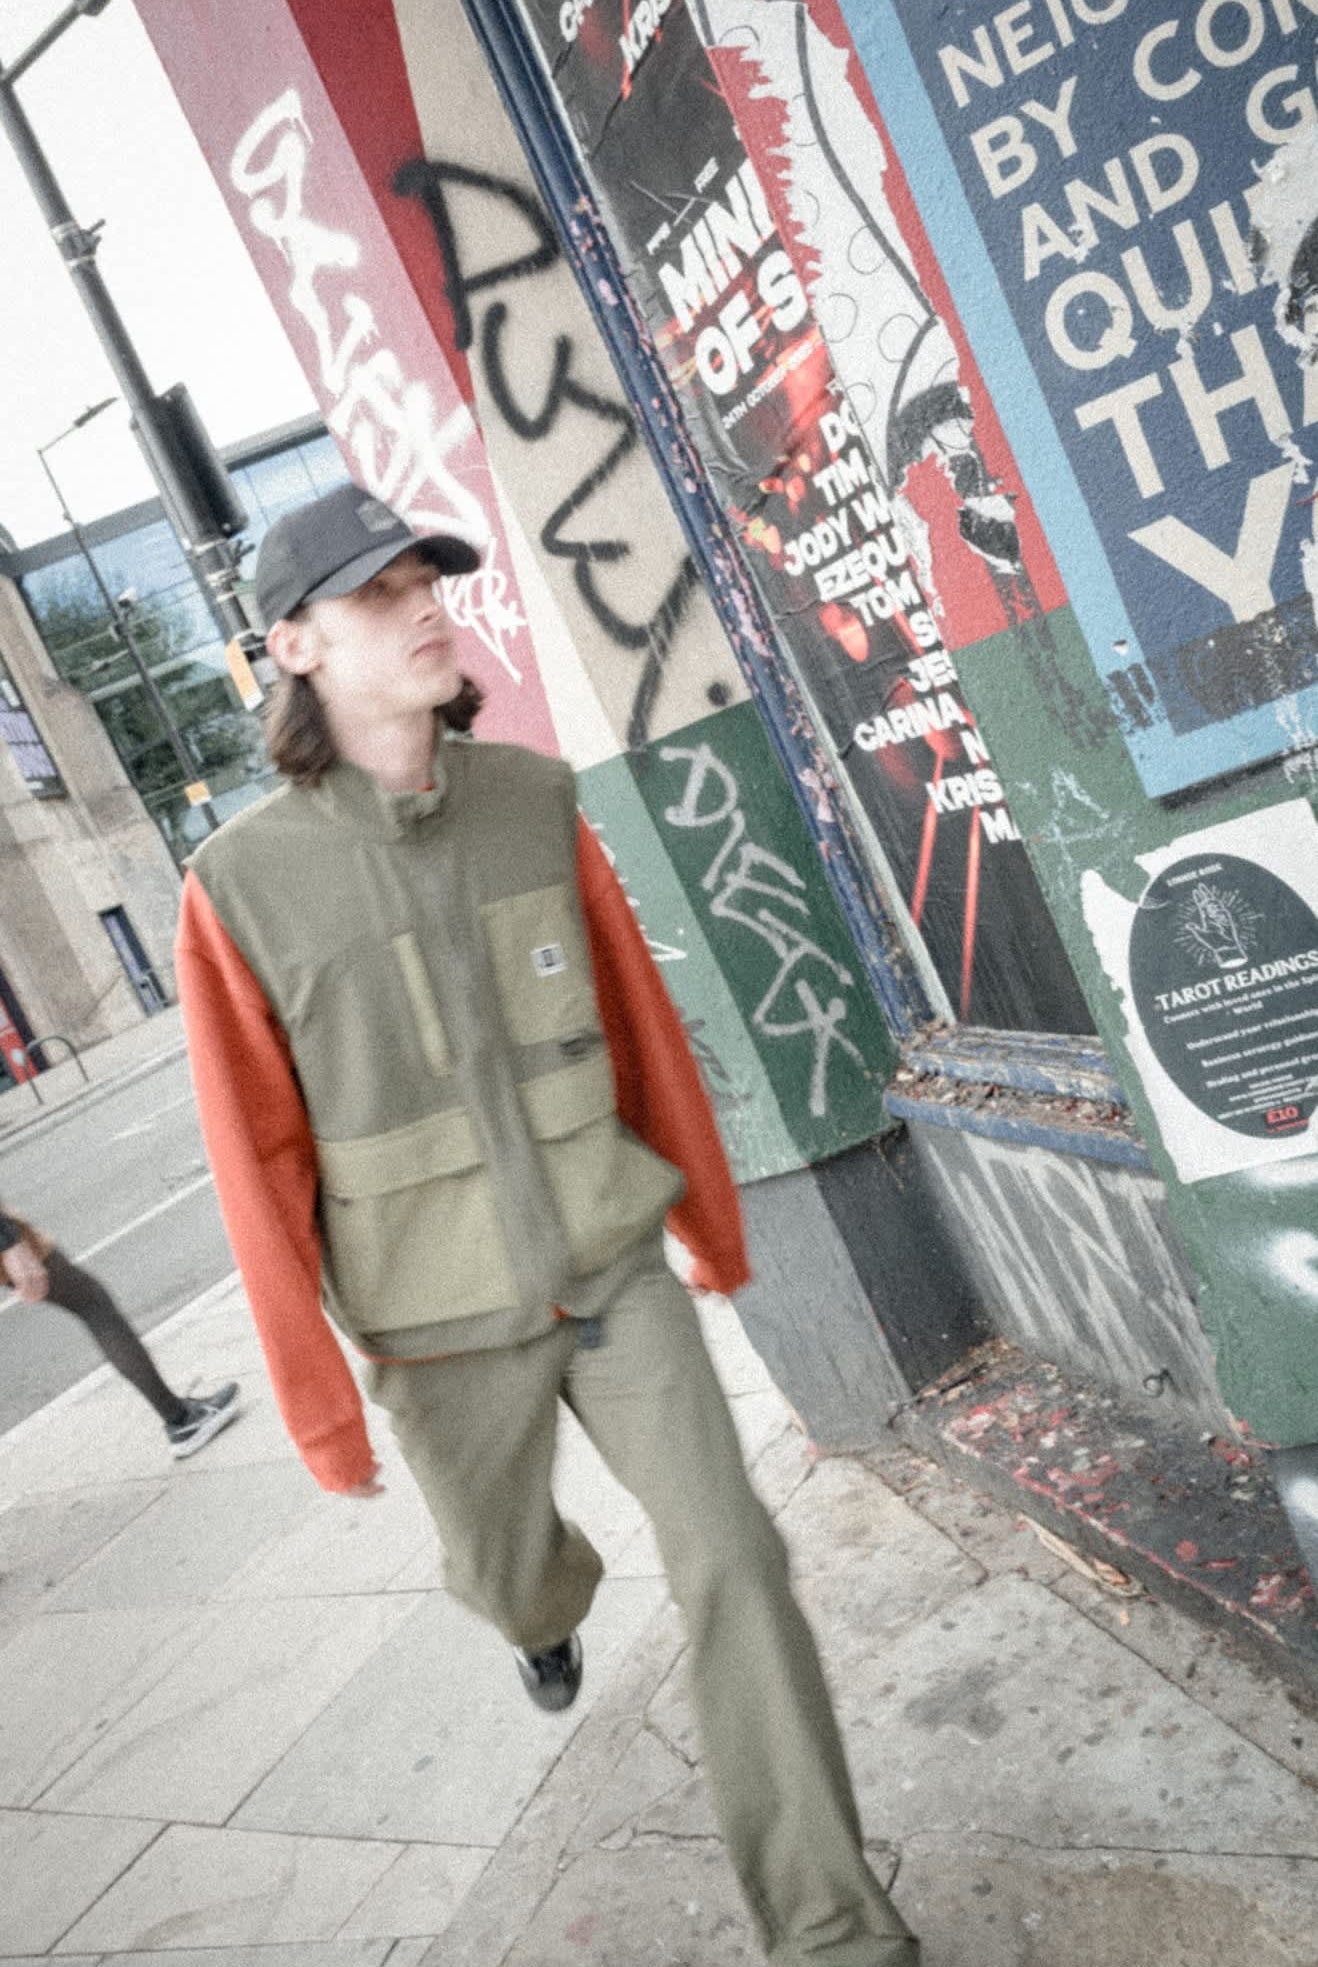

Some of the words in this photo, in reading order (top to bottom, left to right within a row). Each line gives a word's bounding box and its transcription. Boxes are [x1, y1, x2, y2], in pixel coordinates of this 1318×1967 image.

[970, 75, 1078, 199] BY
[1022, 133, 1199, 282] AND
[1246, 54, 1318, 145] G
[1045, 182, 1265, 371] QUI
[695, 289, 761, 396] OF
[757, 249, 808, 332] S
[1074, 303, 1318, 498] TH
[813, 447, 870, 506] TIM
[784, 507, 852, 576] JODY
[851, 479, 894, 532] W
[814, 528, 909, 602] EZEQU
[849, 571, 921, 626] TOM
[853, 691, 967, 751] CARINA
[926, 768, 1005, 814] KRIS
[1155, 978, 1221, 1011] TAROT
[1223, 949, 1318, 992] READINGS
